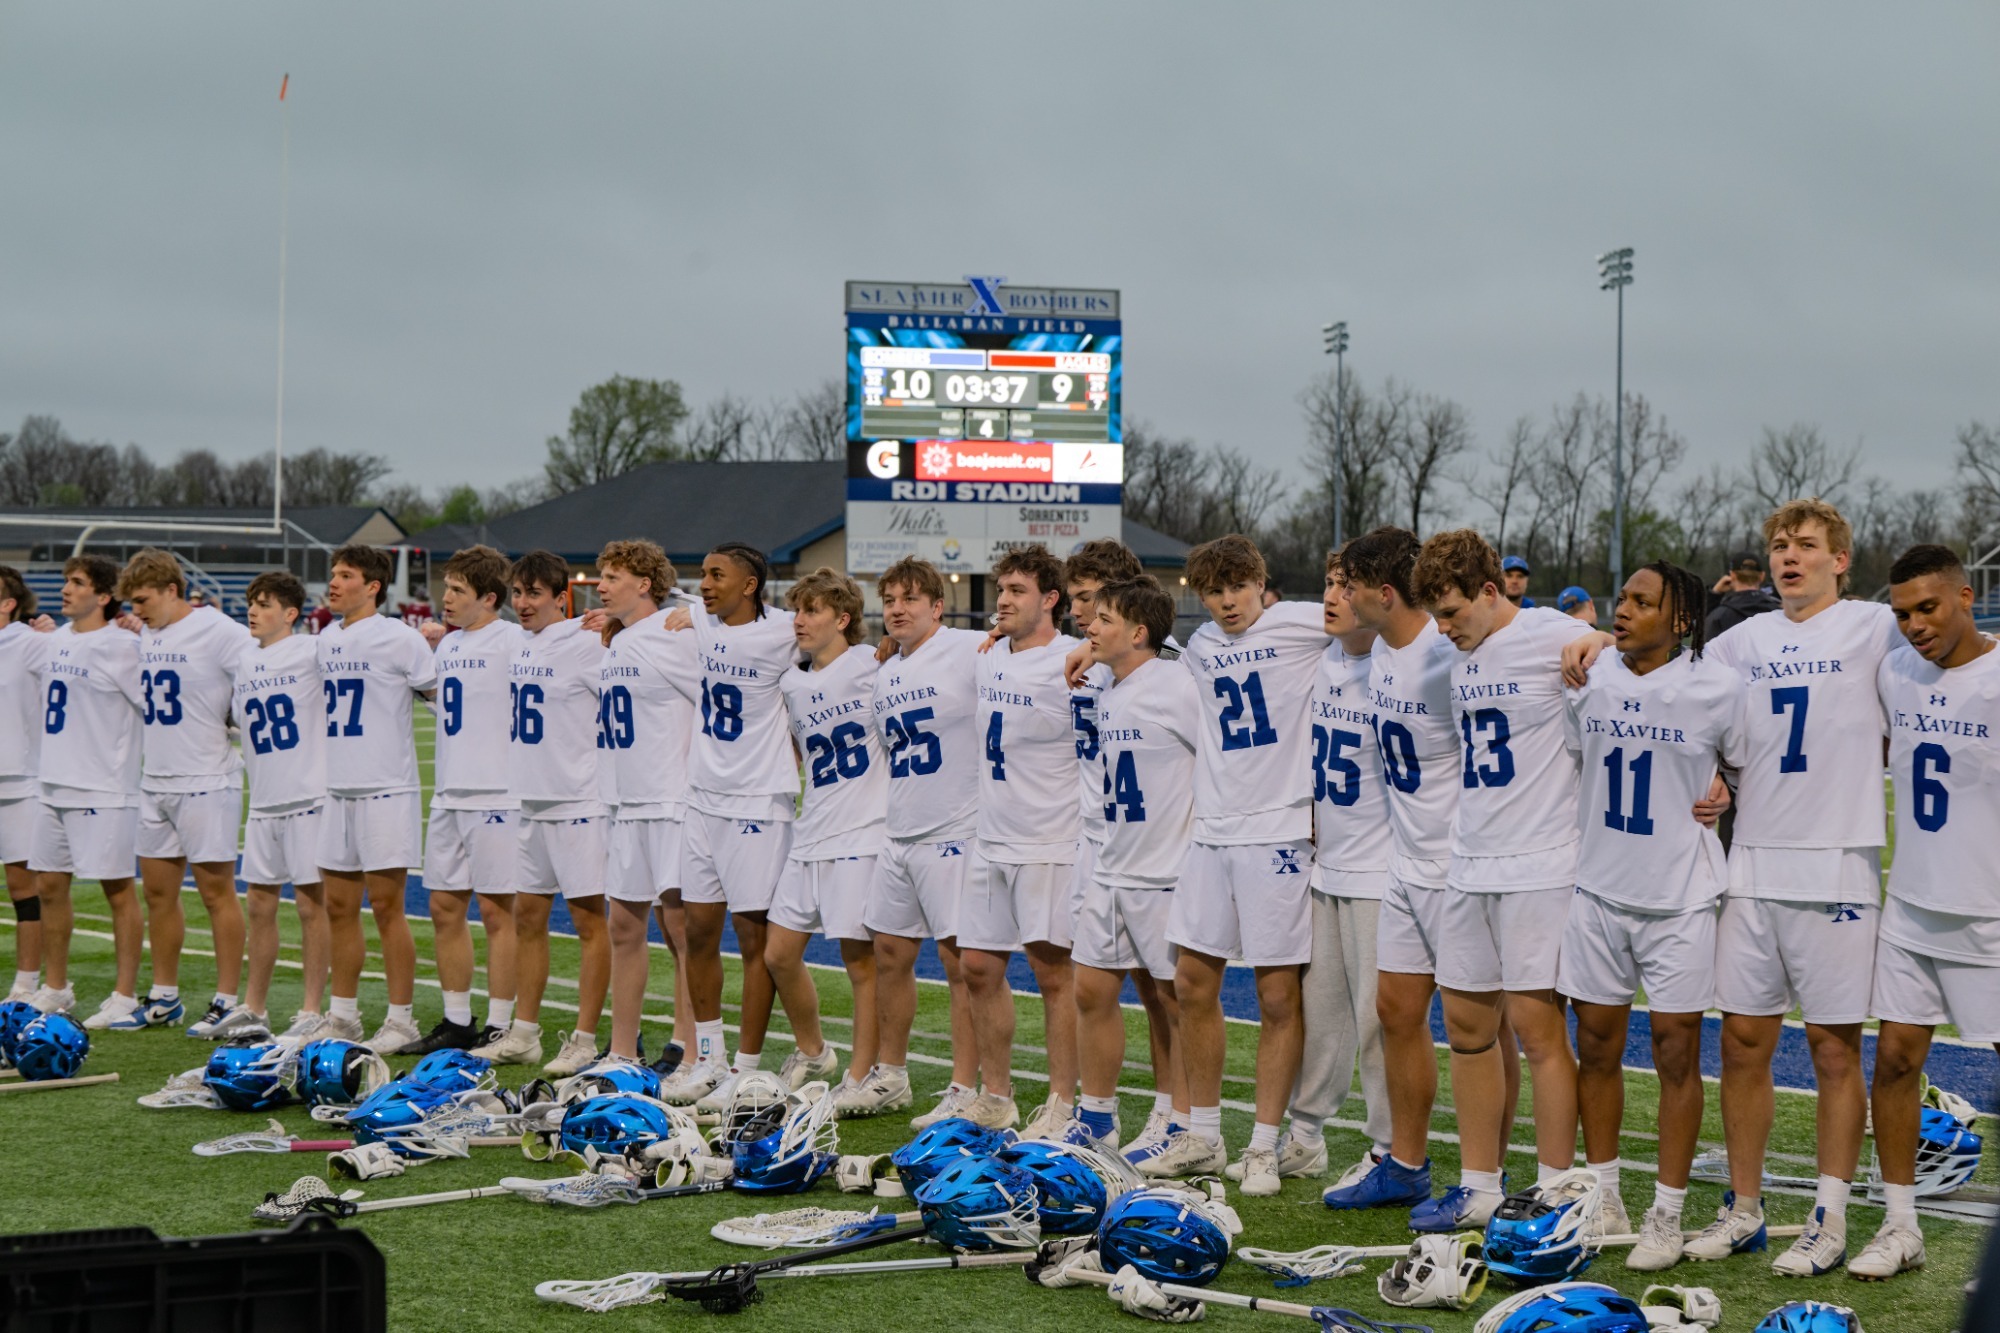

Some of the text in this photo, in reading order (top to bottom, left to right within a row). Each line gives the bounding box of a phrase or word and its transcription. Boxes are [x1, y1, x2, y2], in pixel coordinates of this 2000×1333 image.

[963, 275, 1008, 317] X
[1009, 293, 1110, 311] BOMBERS
[888, 315, 1086, 333] BALLABAN FIELD
[889, 370, 931, 399] 10
[945, 375, 1029, 403] 03:37
[1051, 374, 1073, 402] 9
[979, 419, 994, 438] 4
[866, 440, 900, 479] G
[891, 481, 1080, 502] RDI STADIUM
[1019, 507, 1090, 522] SORRENTO'S
[1028, 524, 1080, 537] BEST PIZZA
[49, 661, 89, 679] XAVIER
[144, 652, 187, 664] XAVIER
[325, 661, 371, 673] XAVIER
[442, 659, 487, 672] XAVIER
[512, 663, 554, 677] XAVIER
[704, 655, 760, 679] XAVIER
[1213, 647, 1279, 669] XAVIER
[1750, 659, 1843, 682] ST. XAVIER
[141, 669, 183, 726] 33
[250, 675, 297, 692] XAVIER
[886, 686, 938, 709] XAVIER
[987, 686, 1034, 707] XAVIER
[1459, 682, 1522, 702] XAVIER
[45, 679, 67, 735] 8
[323, 678, 364, 737] 27
[443, 676, 463, 737] 9
[510, 681, 544, 744] 36
[701, 676, 743, 742] 18
[807, 699, 864, 727] XAVIER
[1214, 670, 1278, 752] 21
[1319, 701, 1372, 726] XAVIER
[1375, 689, 1429, 715] XAVIER
[245, 693, 300, 755] 28
[1099, 728, 1144, 745] XAVIER
[1586, 716, 1686, 743] ST. XAVIER
[1770, 685, 1809, 774] 7
[1894, 709, 1990, 738] ST. XAVIER
[806, 720, 870, 788] 26
[885, 706, 943, 778] 25
[986, 710, 1007, 781] 4
[1371, 712, 1421, 794] 10
[1461, 707, 1516, 789] 13
[1312, 723, 1362, 807] 35
[1603, 746, 1654, 836] 11
[1912, 741, 1952, 833] 6
[1188, 1154, 1216, 1167] balance
